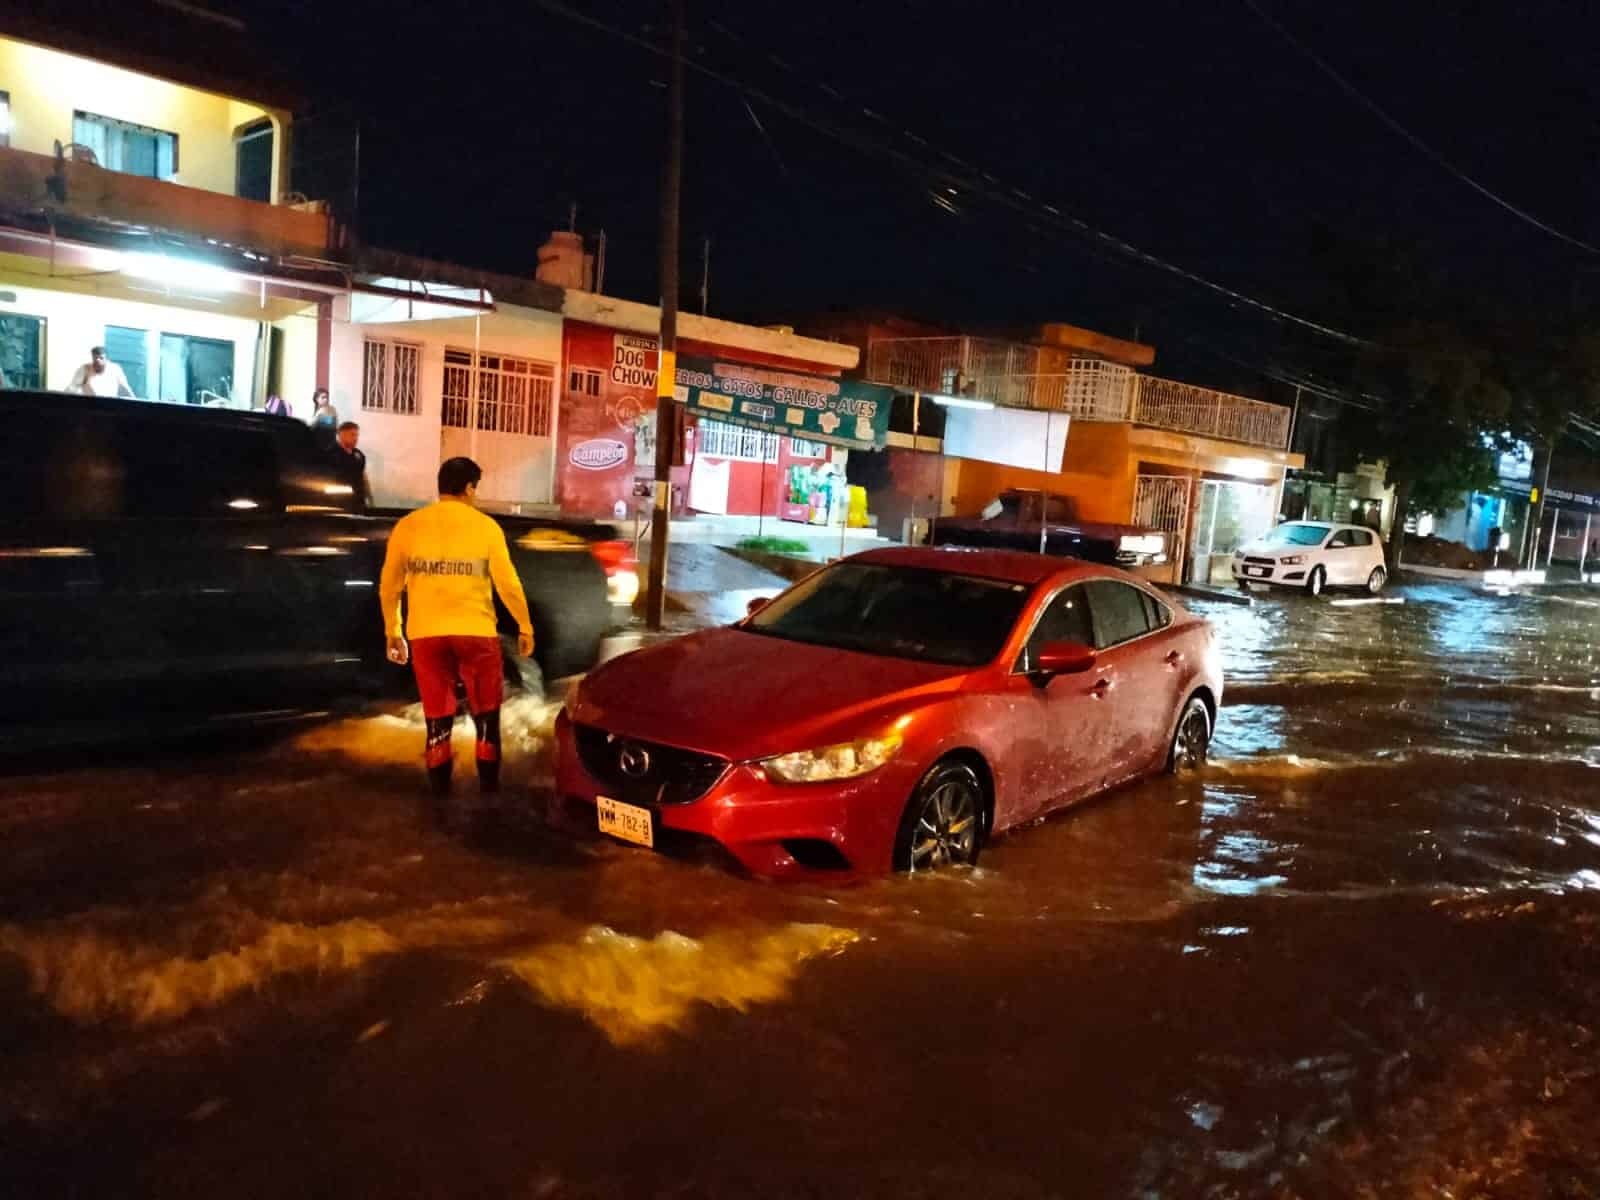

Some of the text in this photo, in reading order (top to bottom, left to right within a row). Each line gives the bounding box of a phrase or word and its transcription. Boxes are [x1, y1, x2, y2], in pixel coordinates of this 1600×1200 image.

[615, 346, 644, 368] DOG
[612, 365, 657, 387] CHOW
[676, 368, 712, 389] ERROS
[721, 378, 763, 398] GATOS
[773, 386, 827, 409] GALLOS
[837, 398, 877, 417] AVES
